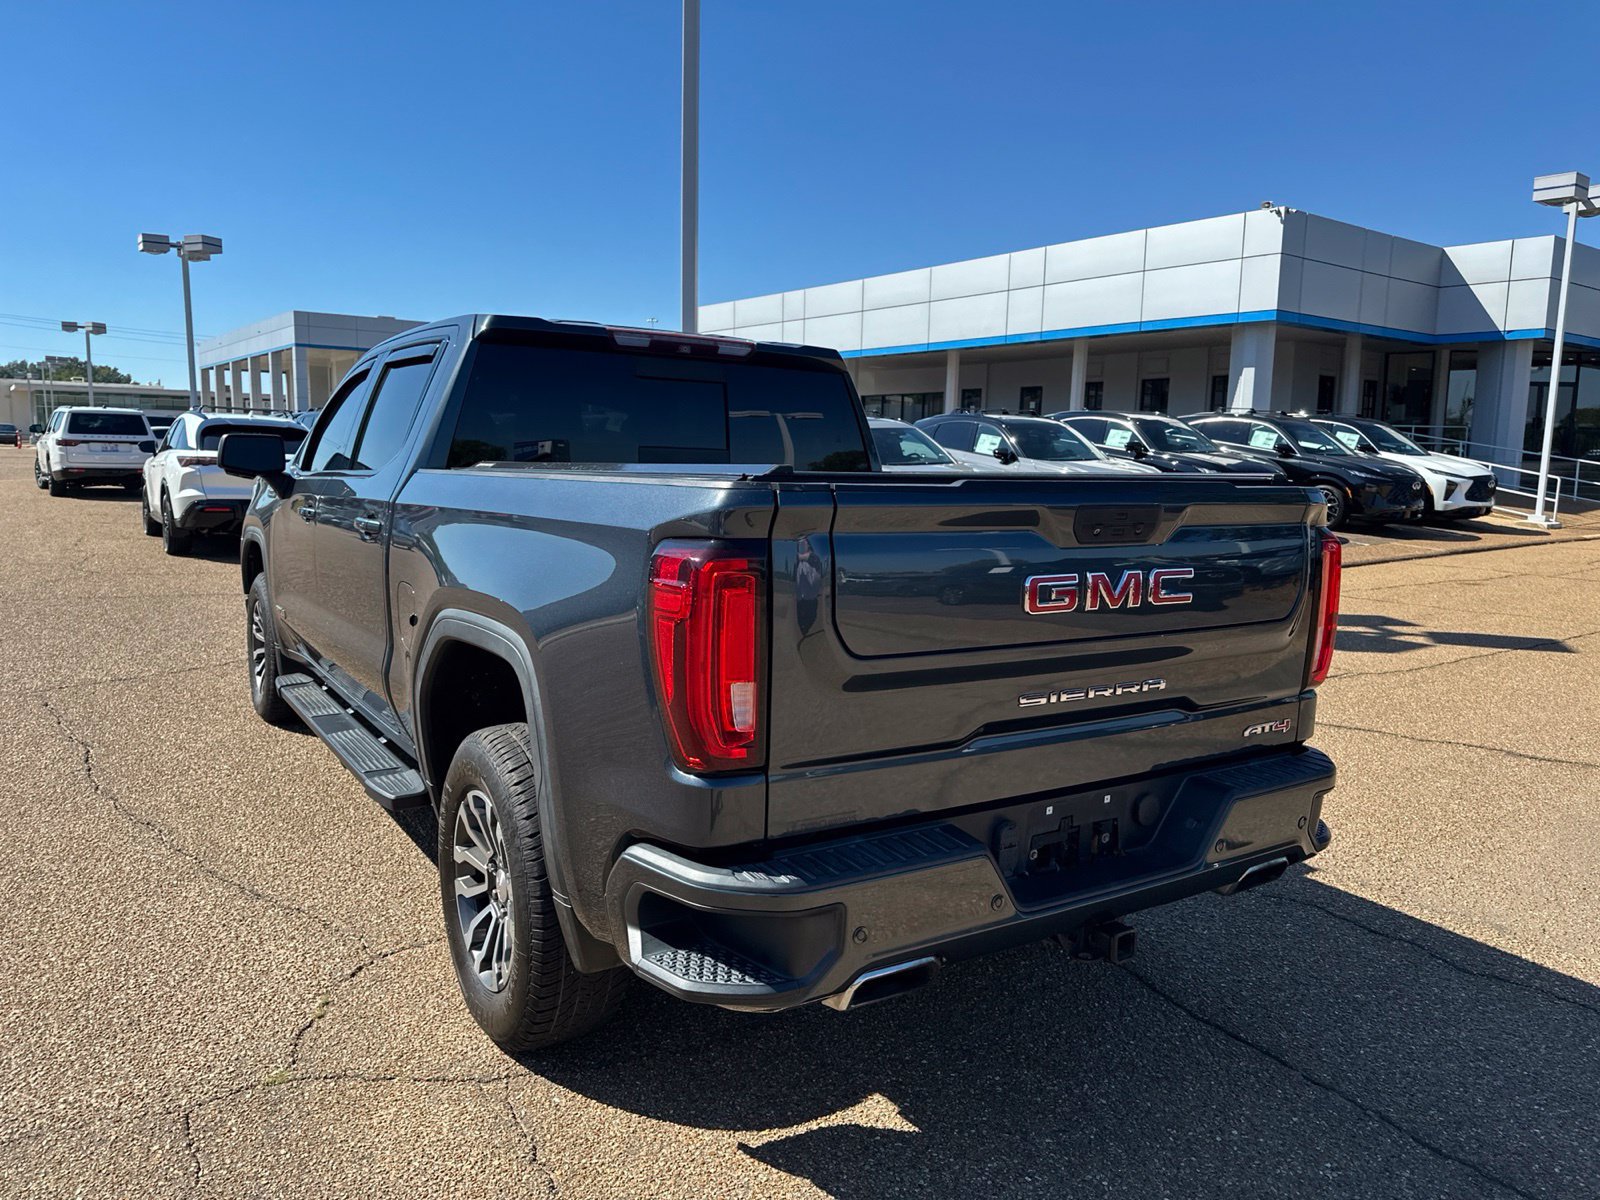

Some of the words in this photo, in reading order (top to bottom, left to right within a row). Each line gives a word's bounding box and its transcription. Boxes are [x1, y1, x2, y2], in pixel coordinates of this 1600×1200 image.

[1024, 568, 1194, 615] GMC
[1018, 678, 1166, 707] SIERRA
[1243, 719, 1291, 737] AT4
